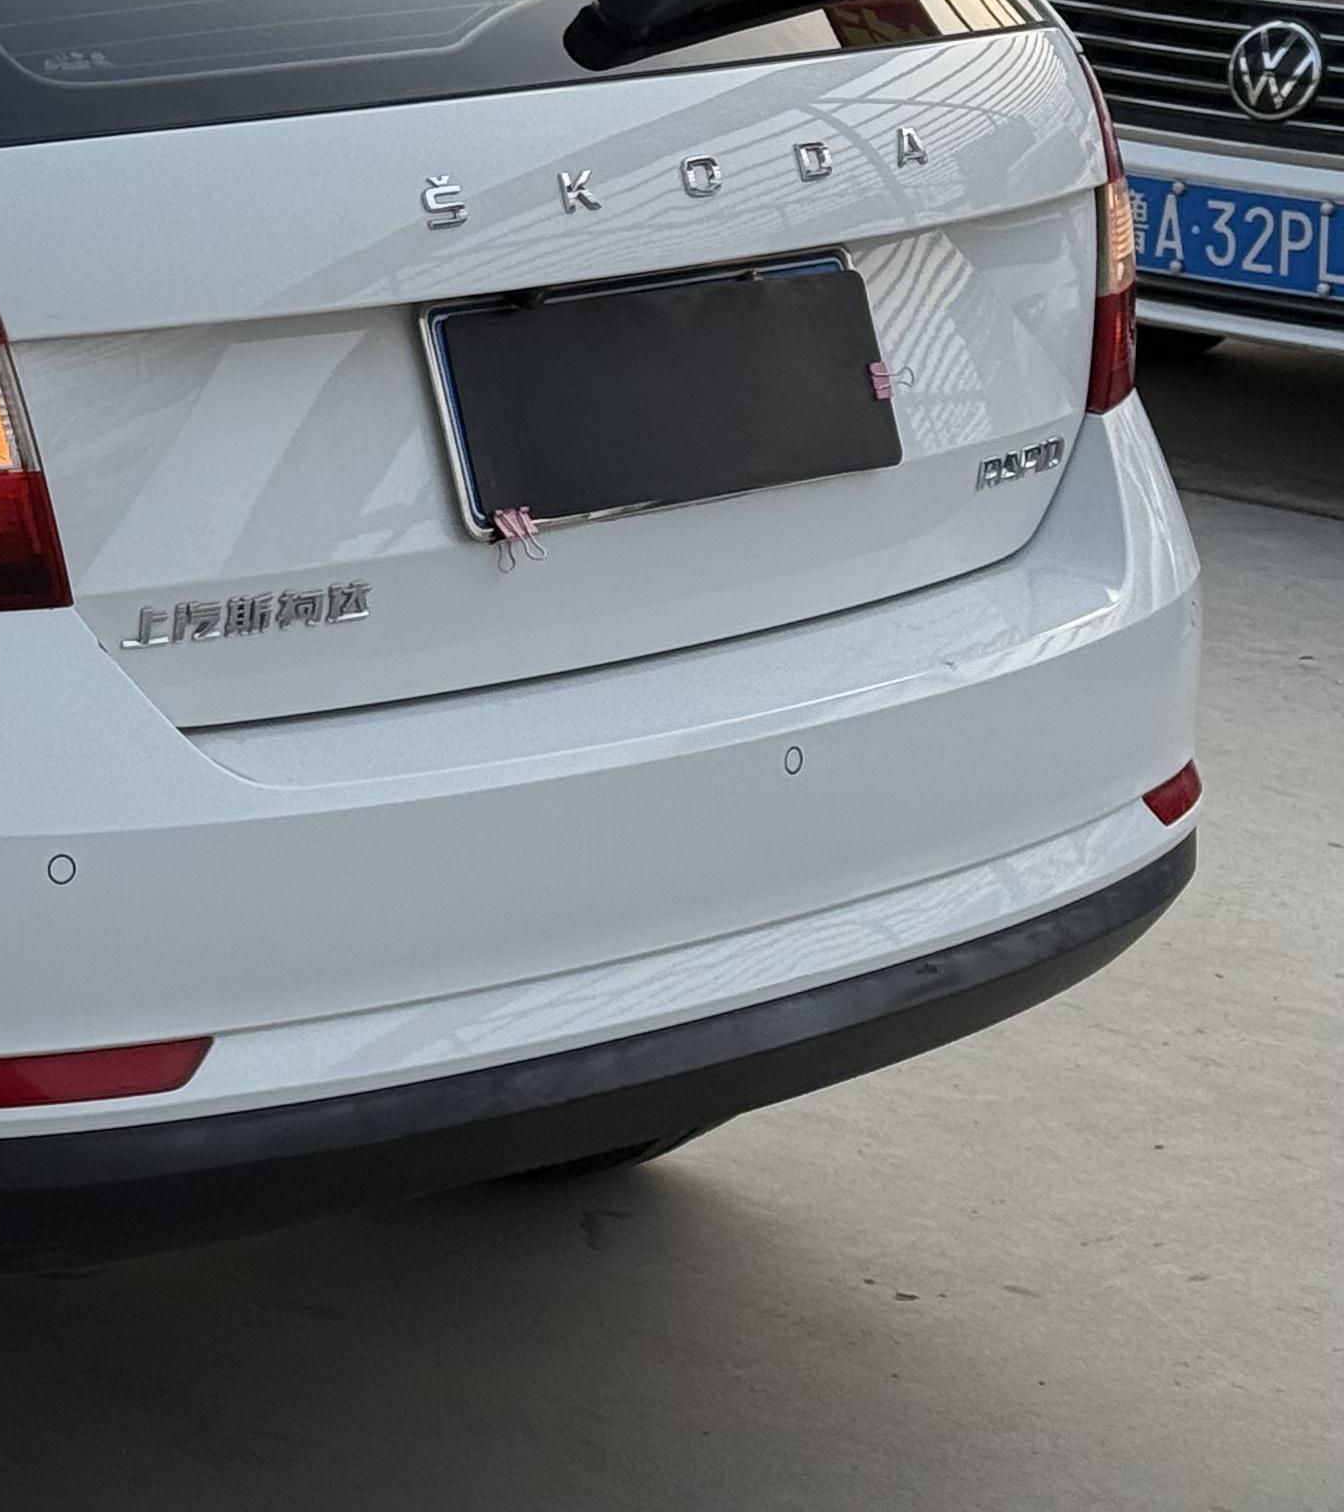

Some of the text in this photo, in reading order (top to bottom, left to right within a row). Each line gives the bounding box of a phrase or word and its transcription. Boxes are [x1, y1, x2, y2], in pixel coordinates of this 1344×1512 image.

[119, 580, 373, 649] 上汽斯柯达
